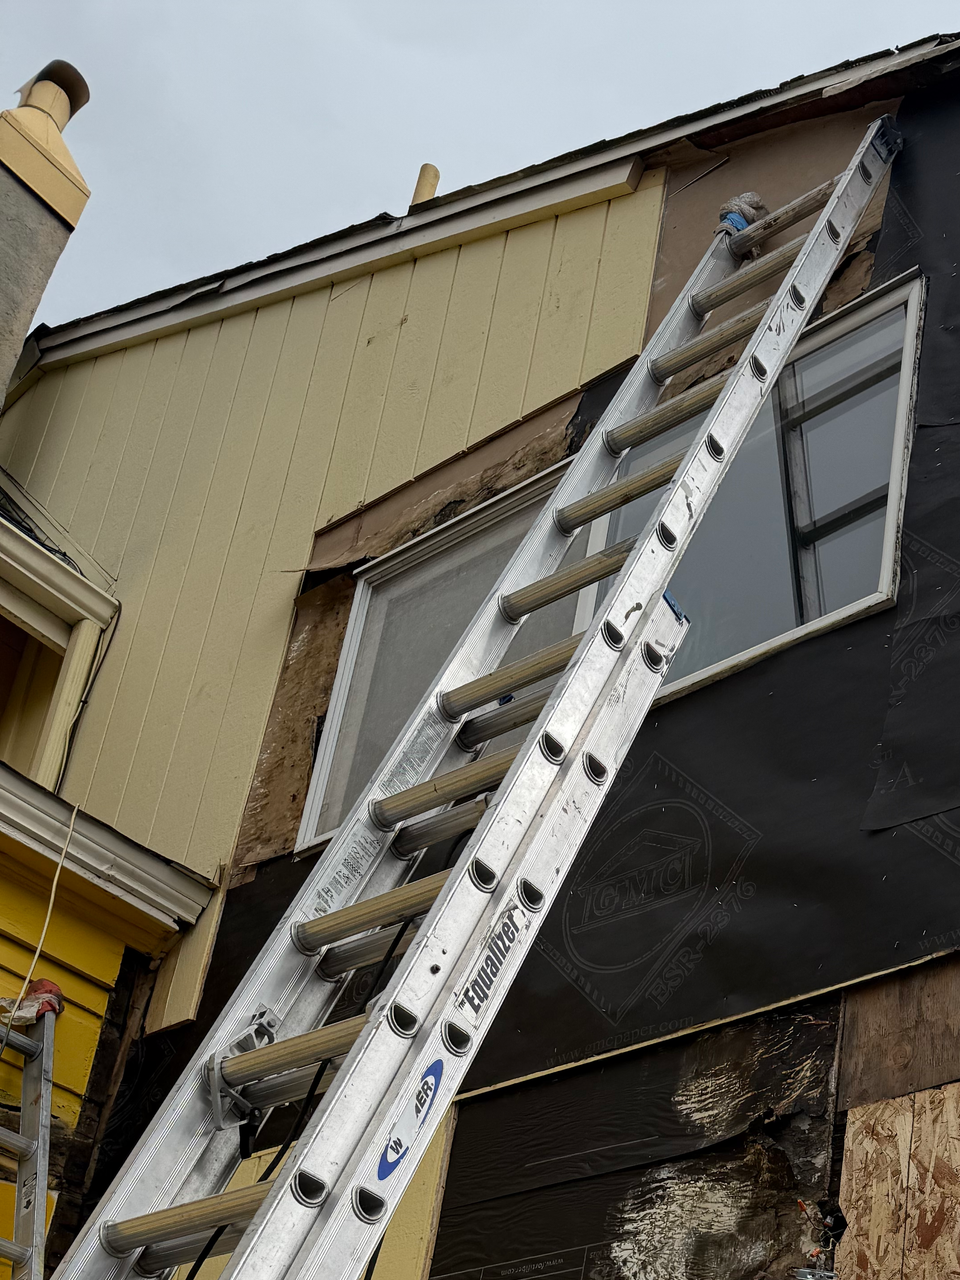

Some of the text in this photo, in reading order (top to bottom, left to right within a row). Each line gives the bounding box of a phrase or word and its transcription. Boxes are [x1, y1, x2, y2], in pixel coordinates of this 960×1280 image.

[463, 911, 522, 1016] Equalizer
[646, 876, 757, 1011] ESR-2376
[545, 1016, 695, 1068] www.gmcpaper.com
